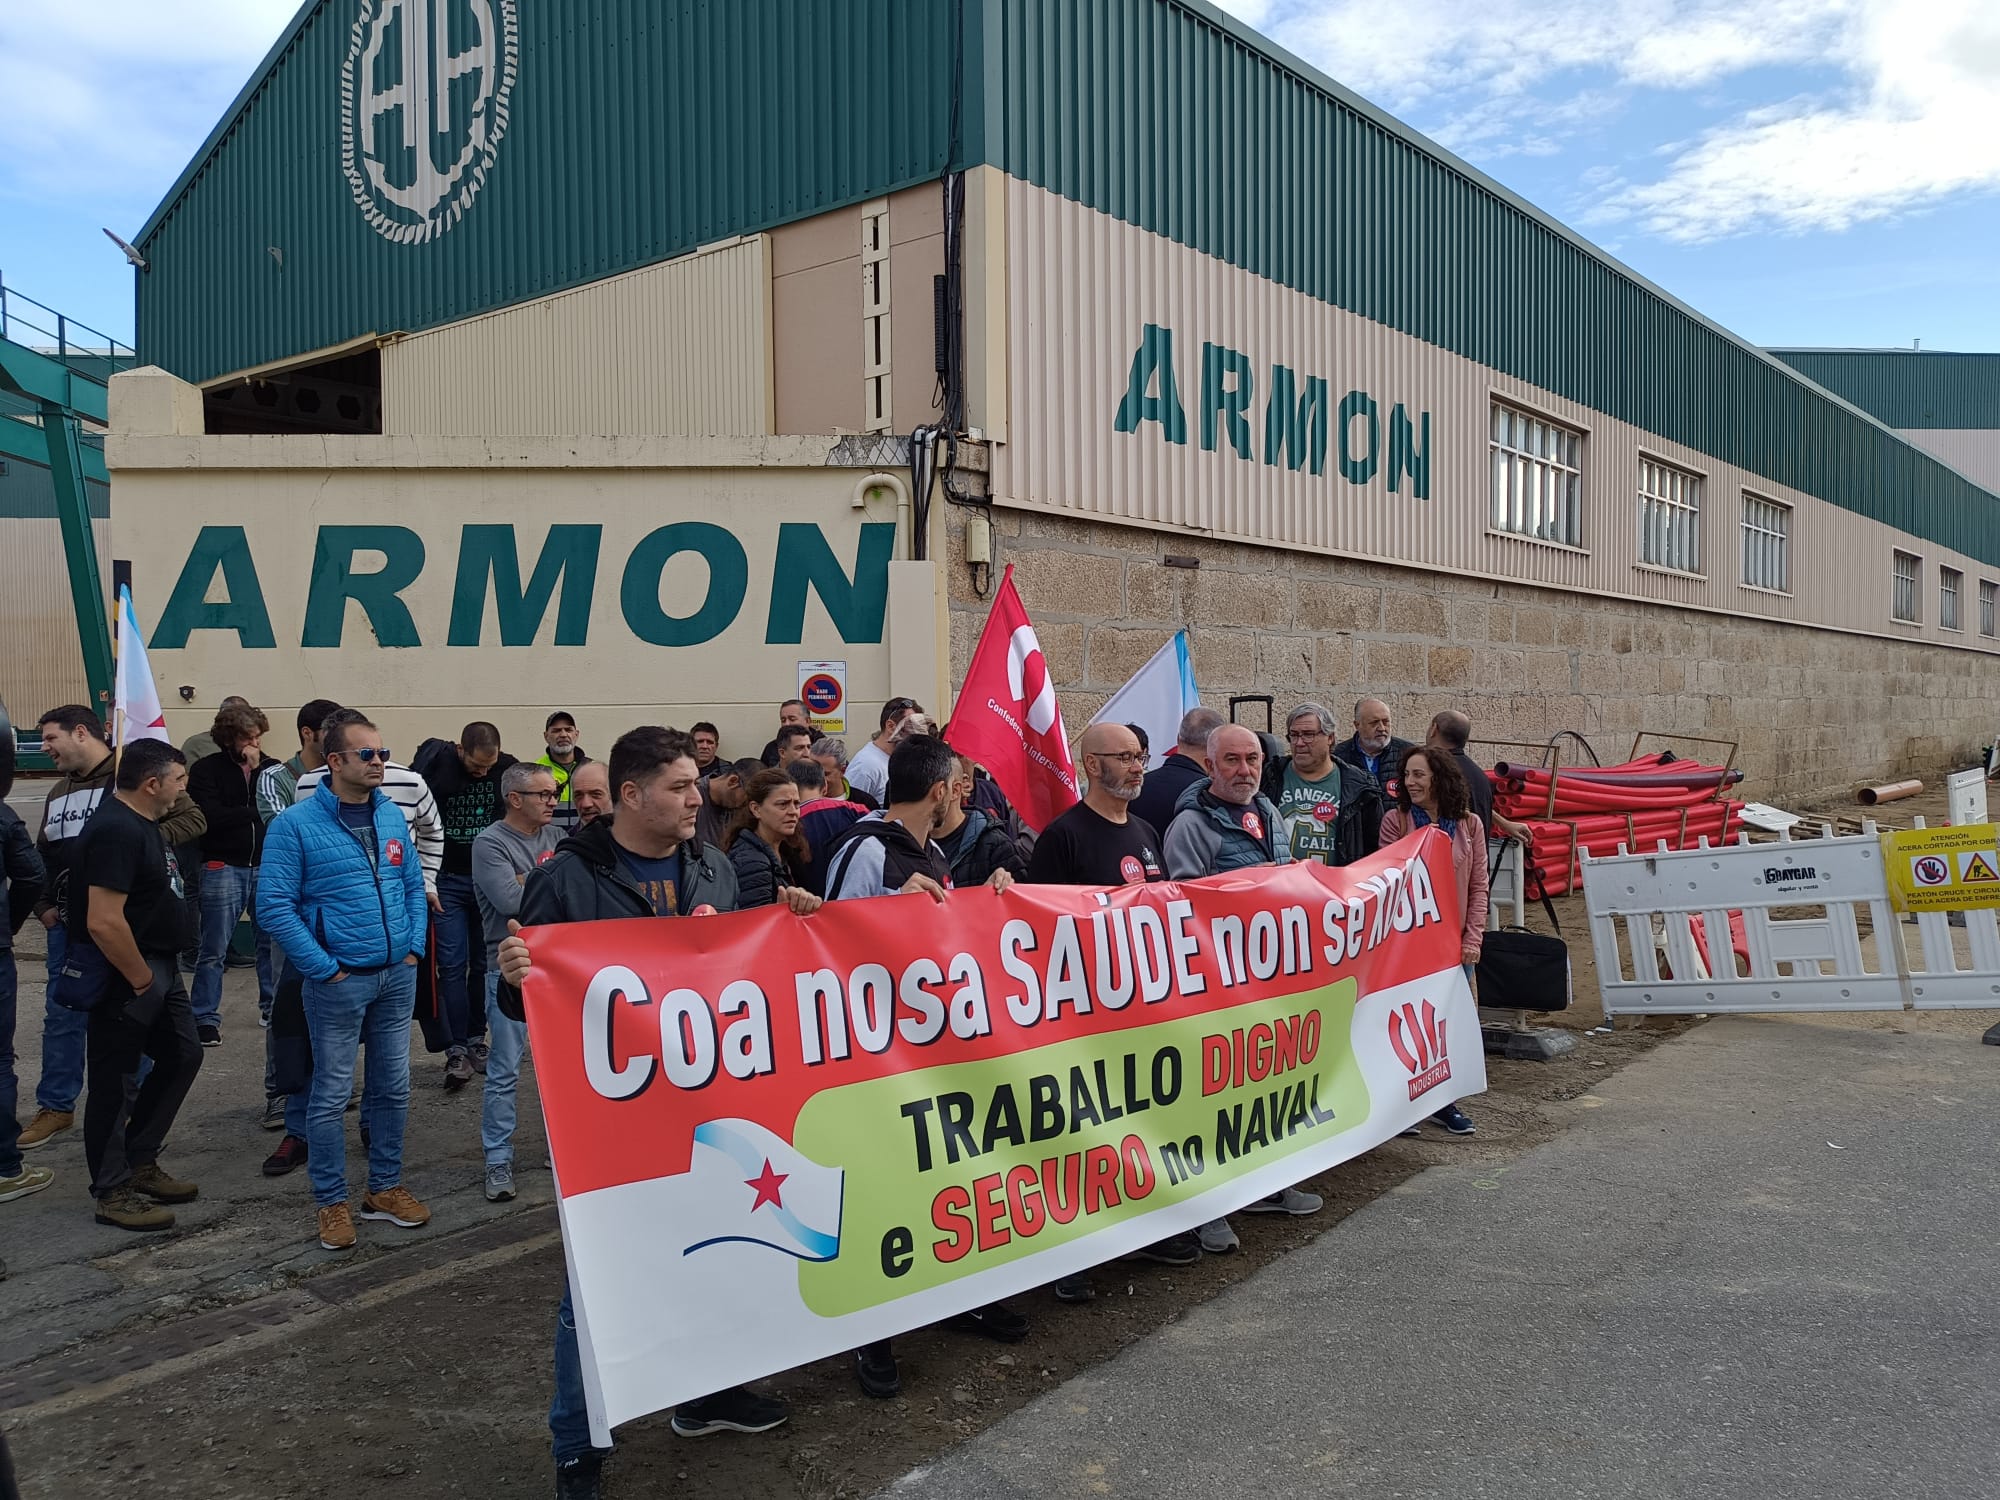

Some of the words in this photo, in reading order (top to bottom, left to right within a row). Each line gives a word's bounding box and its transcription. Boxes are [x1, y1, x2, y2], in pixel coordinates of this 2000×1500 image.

[1114, 323, 1430, 500] ARMON
[148, 521, 897, 649] ARMON
[1906, 891, 1938, 899] PEATÓN
[1938, 889, 1966, 897] CRUCE
[1930, 833, 1969, 842] ATENCIÓN
[582, 965, 777, 1101] Coa
[794, 951, 991, 1066] nosa
[1000, 892, 1206, 1027] SAÚDE
[1211, 903, 1314, 987] non
[1322, 897, 1365, 966] se
[901, 1046, 1182, 1173] TRABALLO
[1202, 1009, 1322, 1097] DIGNO
[1408, 1062, 1449, 1098] INDUSTRIA
[881, 1226, 914, 1279] e
[931, 1134, 1156, 1264] SEGURO
[1159, 1135, 1204, 1186] no
[1215, 1073, 1335, 1165] NAVAL
